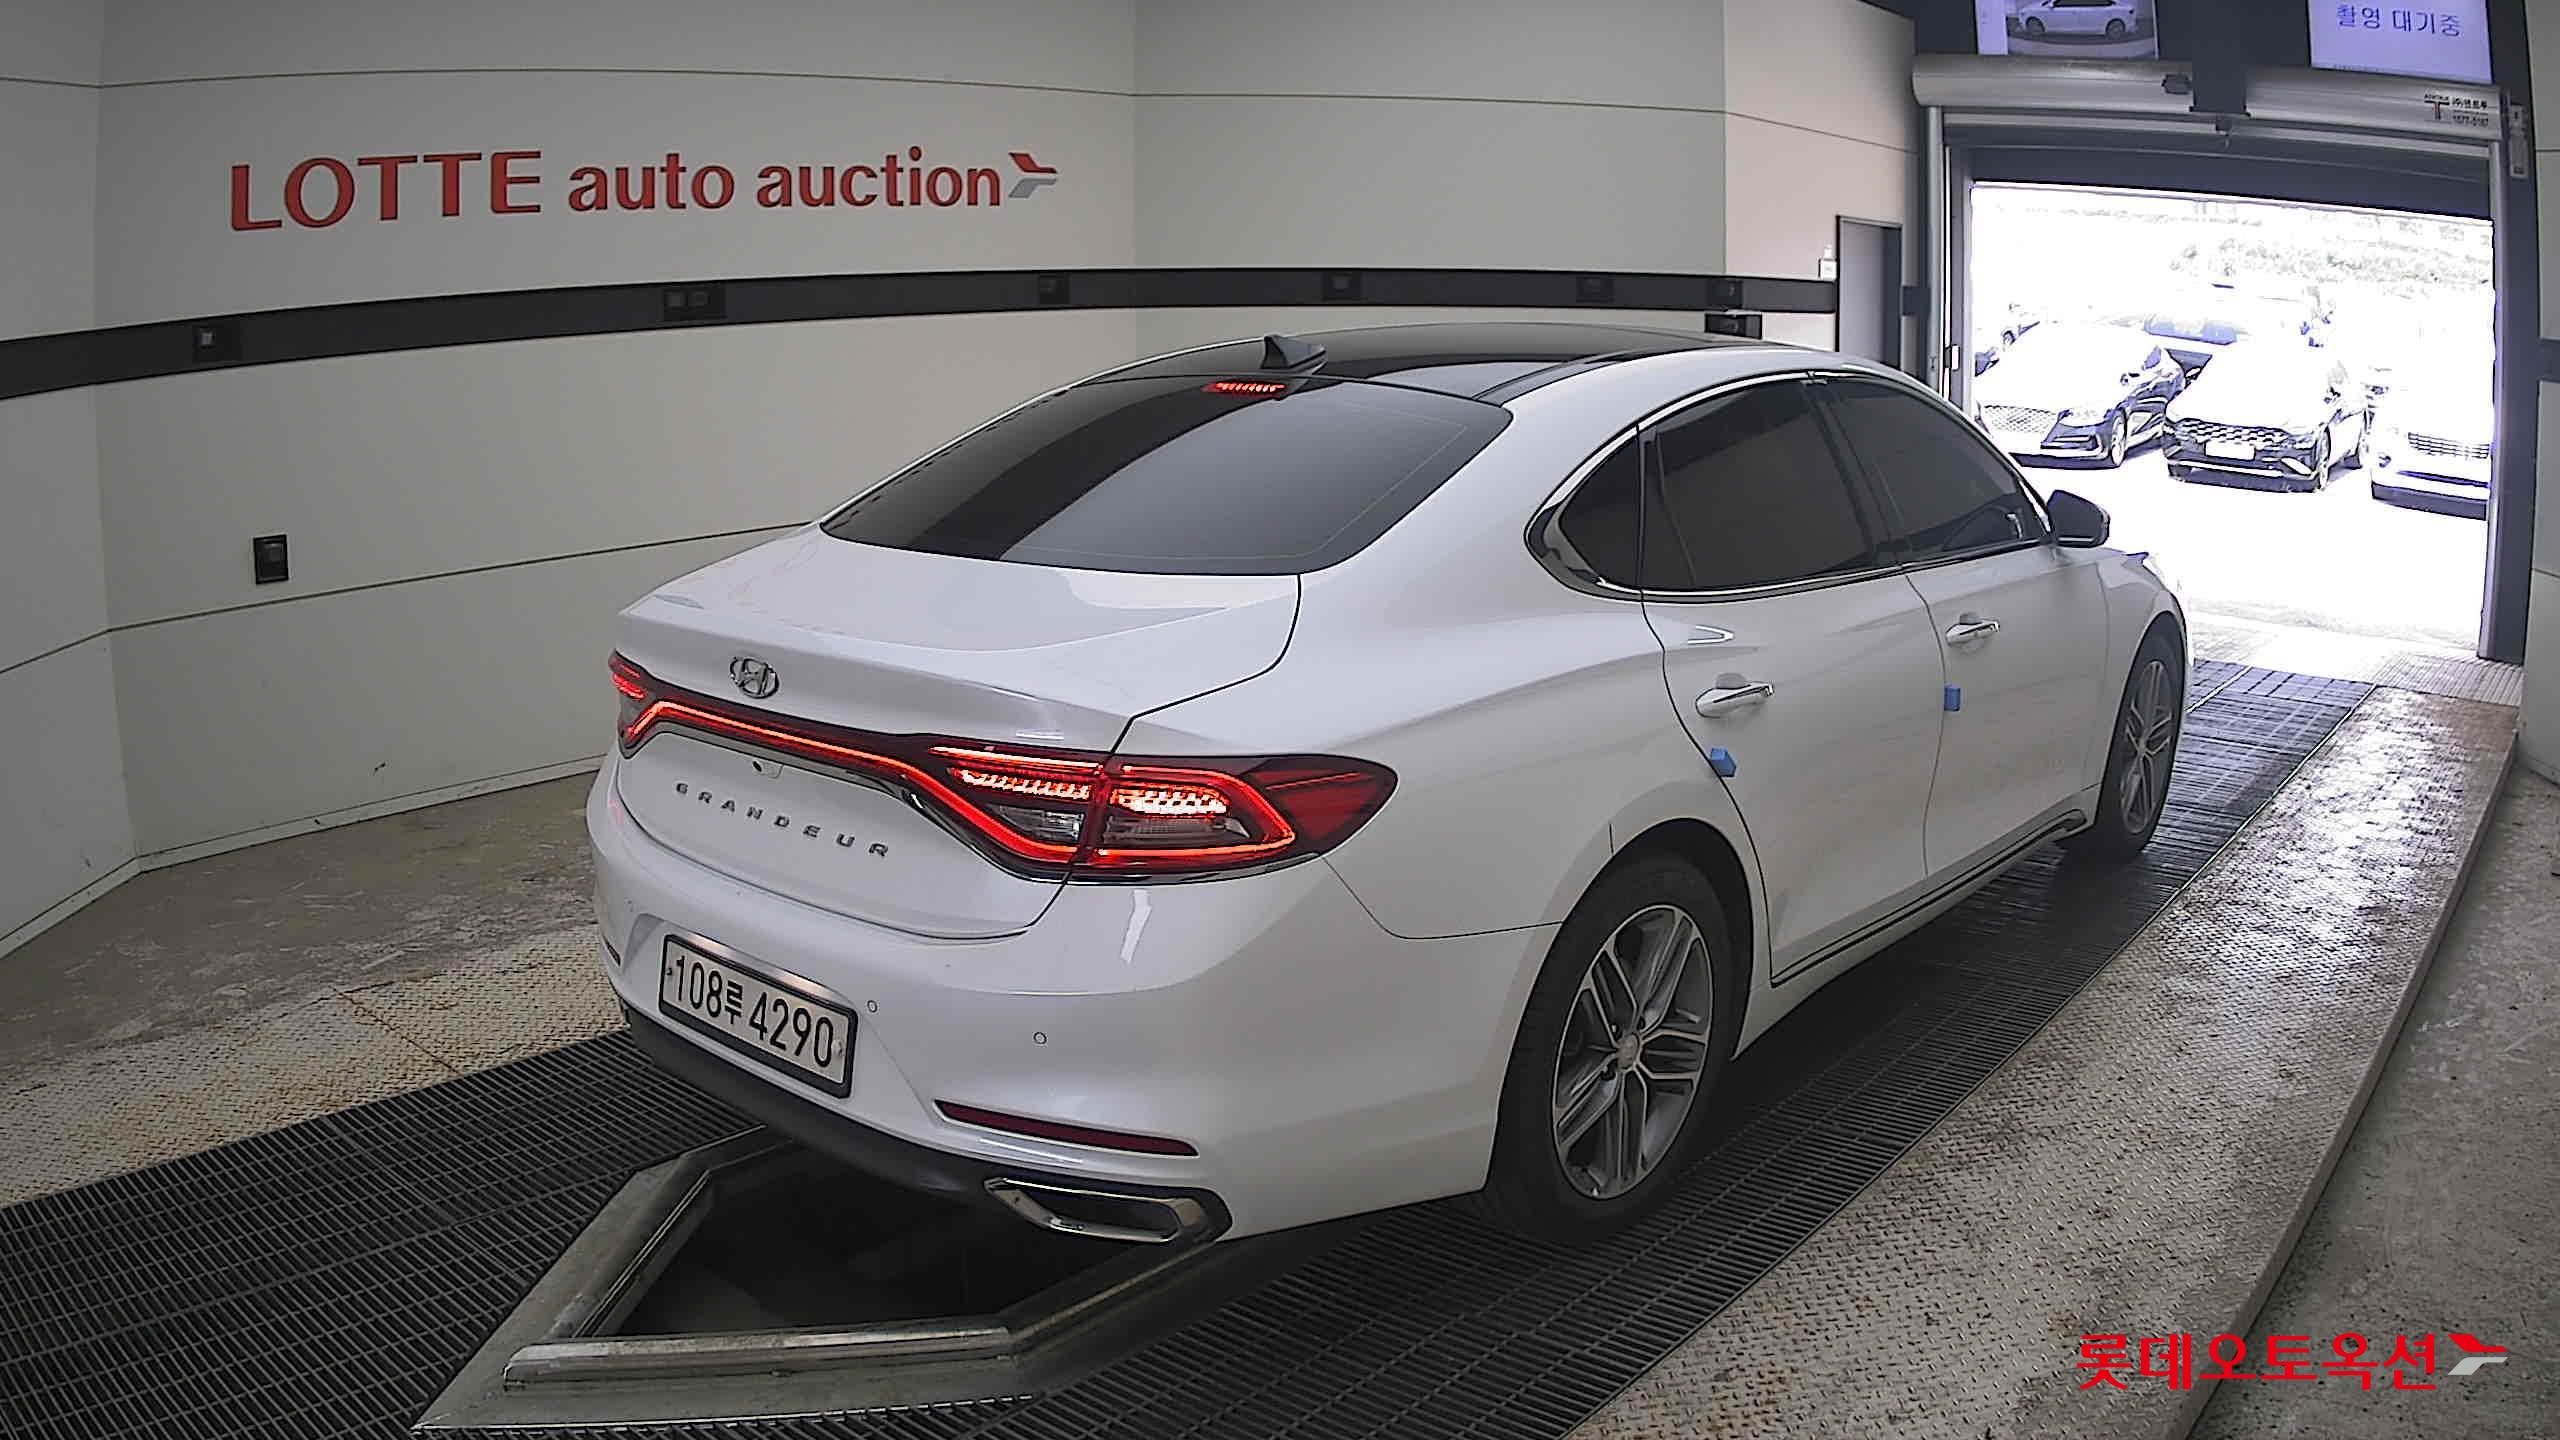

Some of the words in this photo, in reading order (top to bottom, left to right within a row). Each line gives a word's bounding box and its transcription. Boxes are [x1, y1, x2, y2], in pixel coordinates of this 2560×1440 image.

[2337, 4, 2381, 30] 촬영
[2391, 10, 2461, 37] 대기중
[231, 150, 542, 230] LOTTE
[569, 152, 735, 210] auto
[756, 146, 1001, 208] auction
[675, 782, 889, 858] GRANDEUR
[749, 992, 834, 1068] 4290
